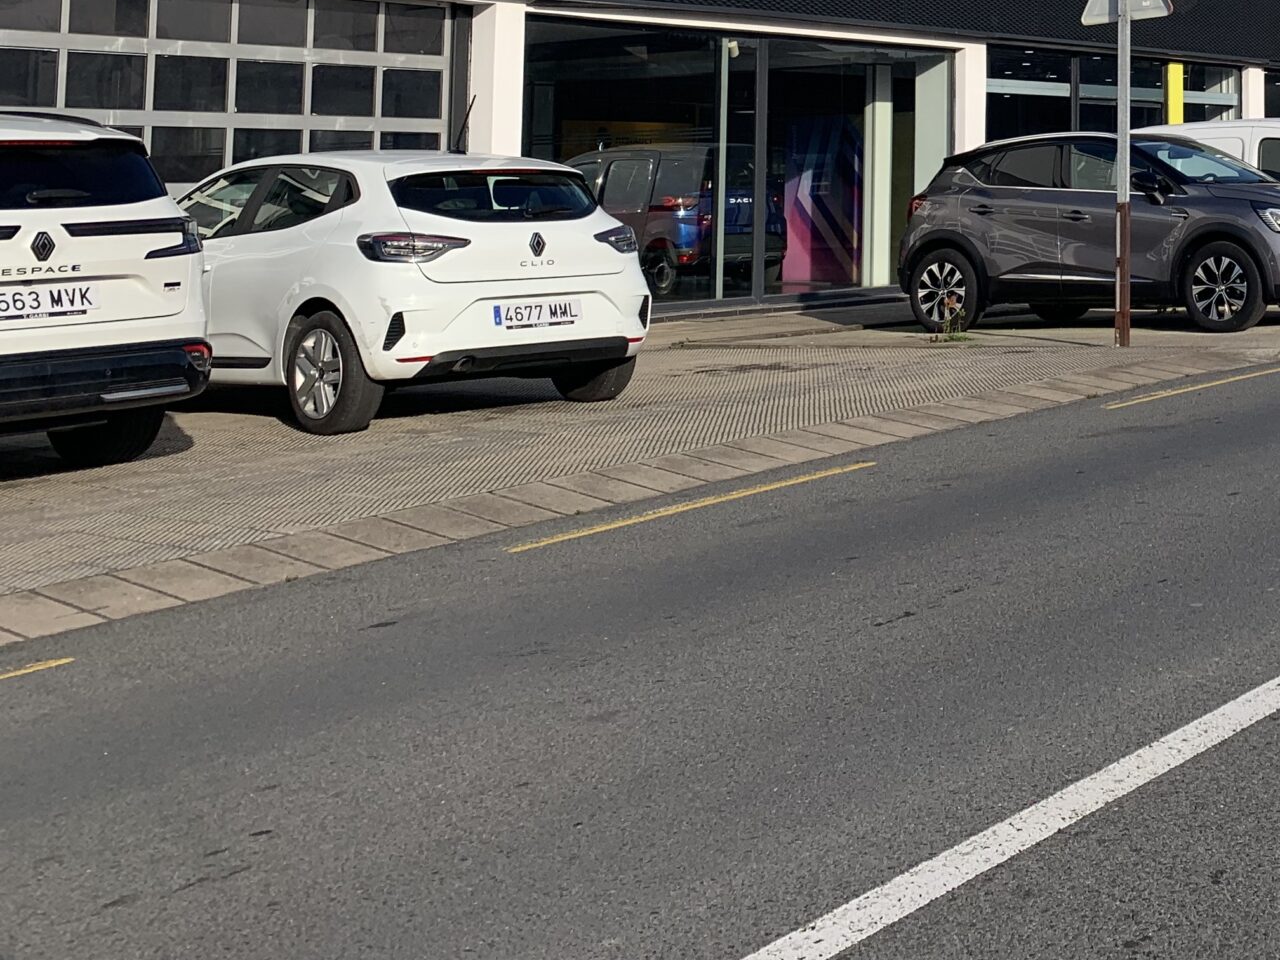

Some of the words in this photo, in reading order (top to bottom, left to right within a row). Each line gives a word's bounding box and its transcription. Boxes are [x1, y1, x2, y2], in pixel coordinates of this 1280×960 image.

[1, 264, 82, 277] ESPACE
[520, 259, 555, 267] CLIO
[49, 286, 93, 309] MVK
[504, 304, 543, 323] 4677
[548, 302, 579, 320] MML
